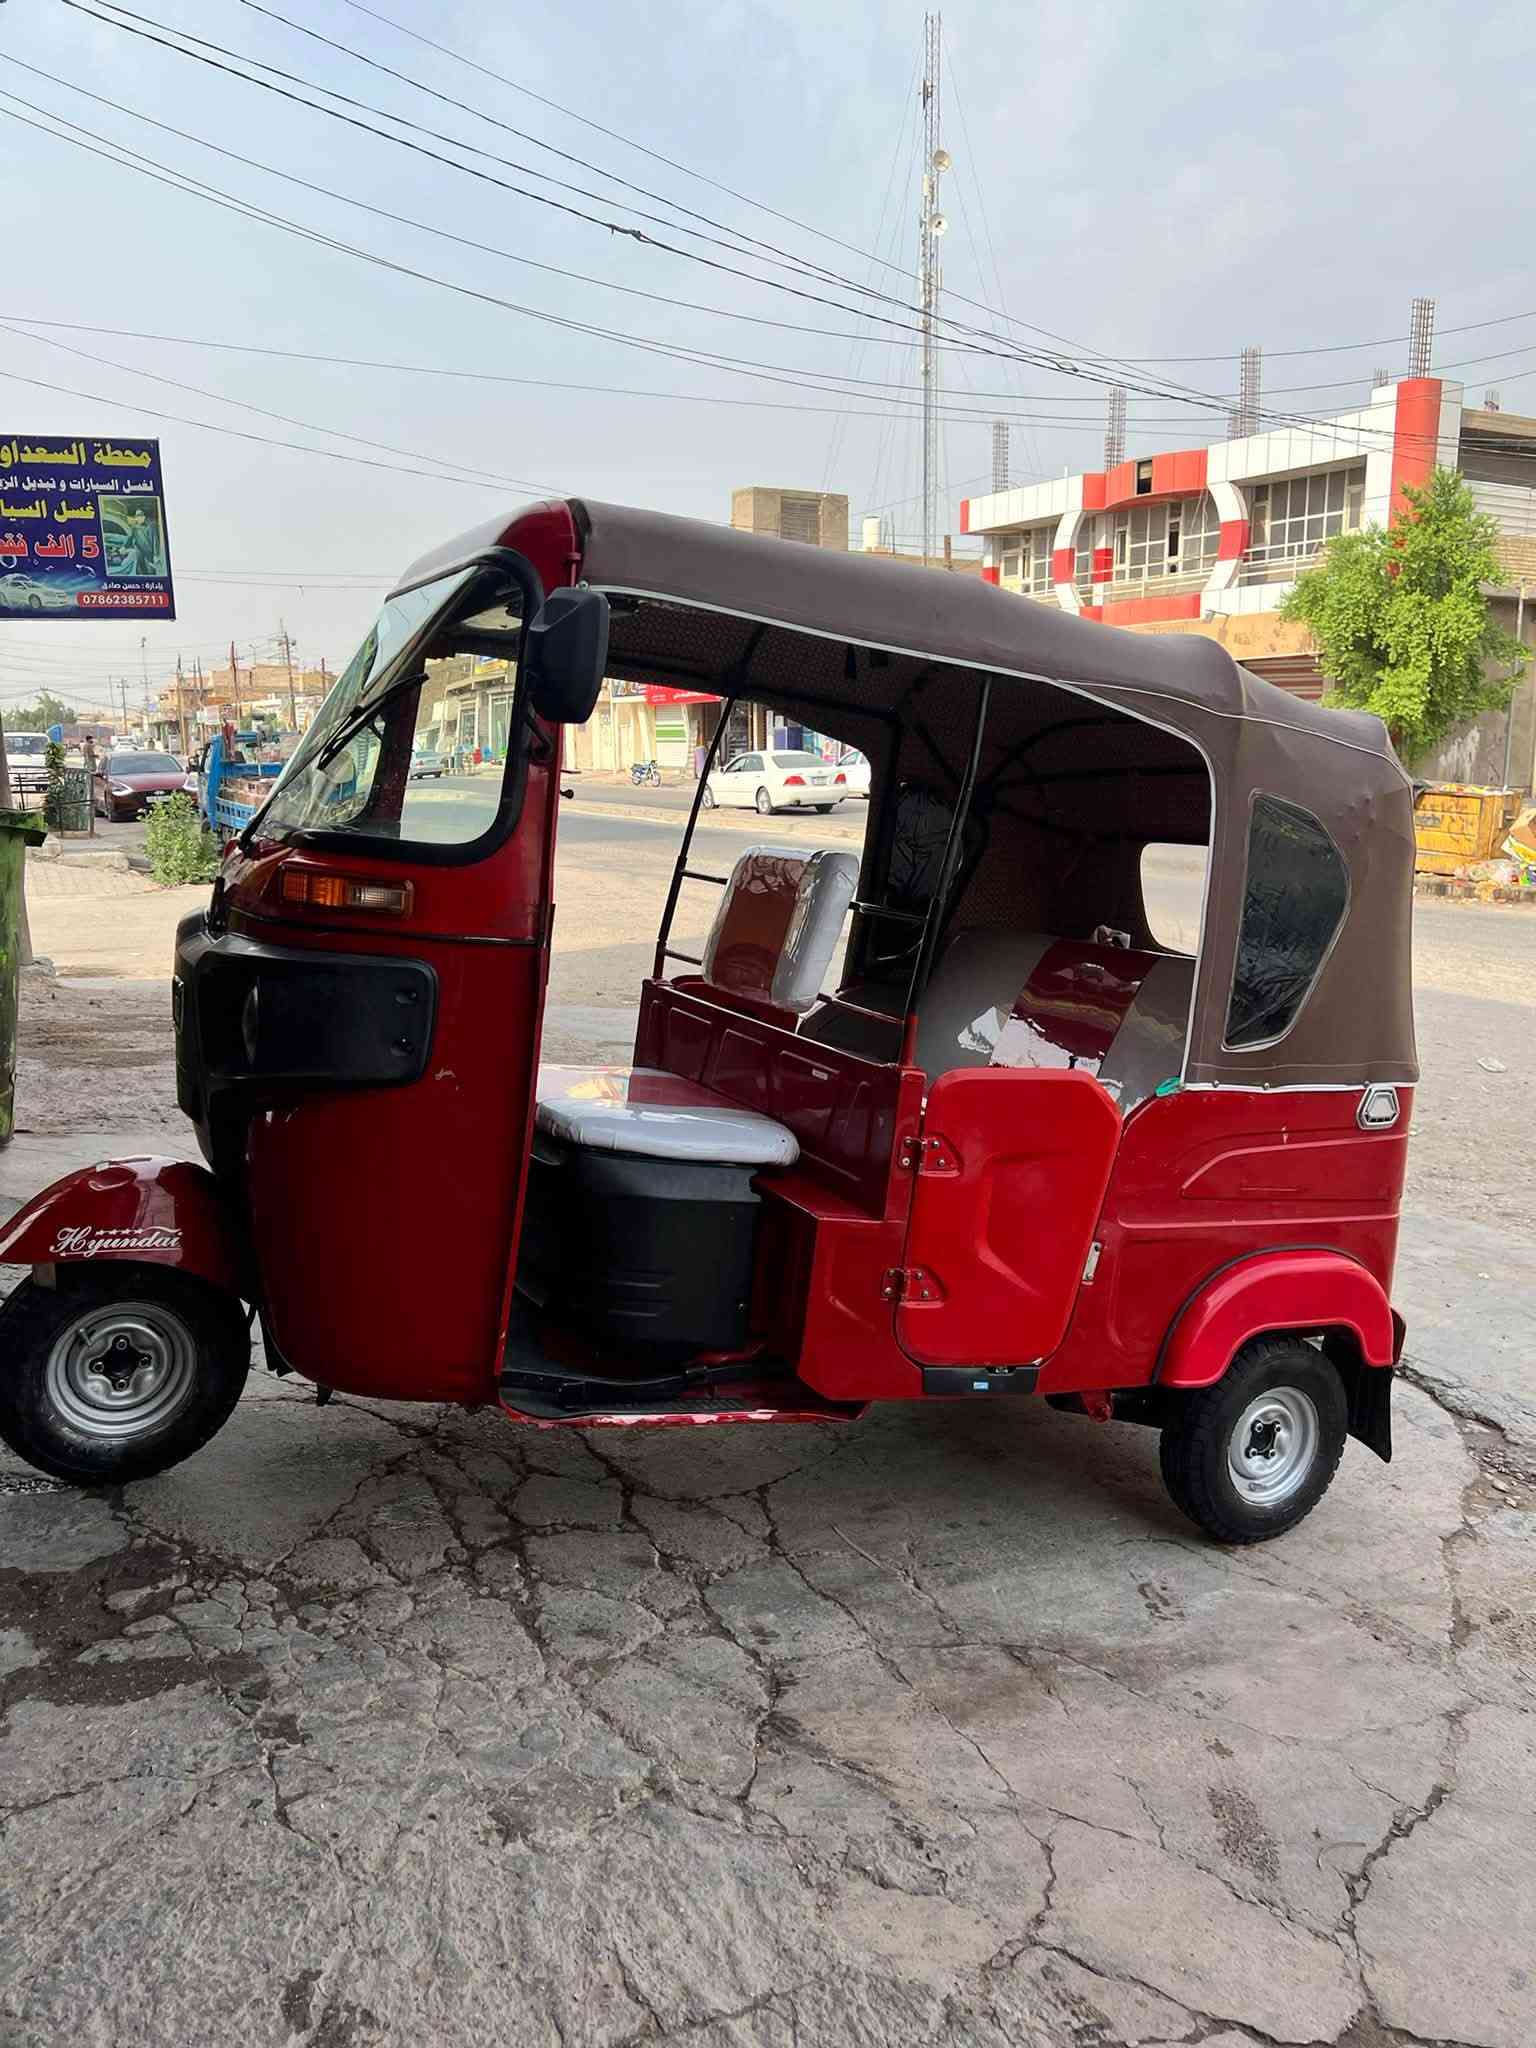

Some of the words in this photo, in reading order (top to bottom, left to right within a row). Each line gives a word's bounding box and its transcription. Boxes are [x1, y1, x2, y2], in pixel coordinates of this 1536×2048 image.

[94, 442, 152, 469] محطة
[22, 477, 56, 492] تبديل
[70, 477, 119, 493] السيارات
[54, 500, 96, 523] غسل
[81, 535, 100, 558] 5
[83, 594, 164, 605] 07862385711
[49, 1226, 183, 1258] Hyundai
